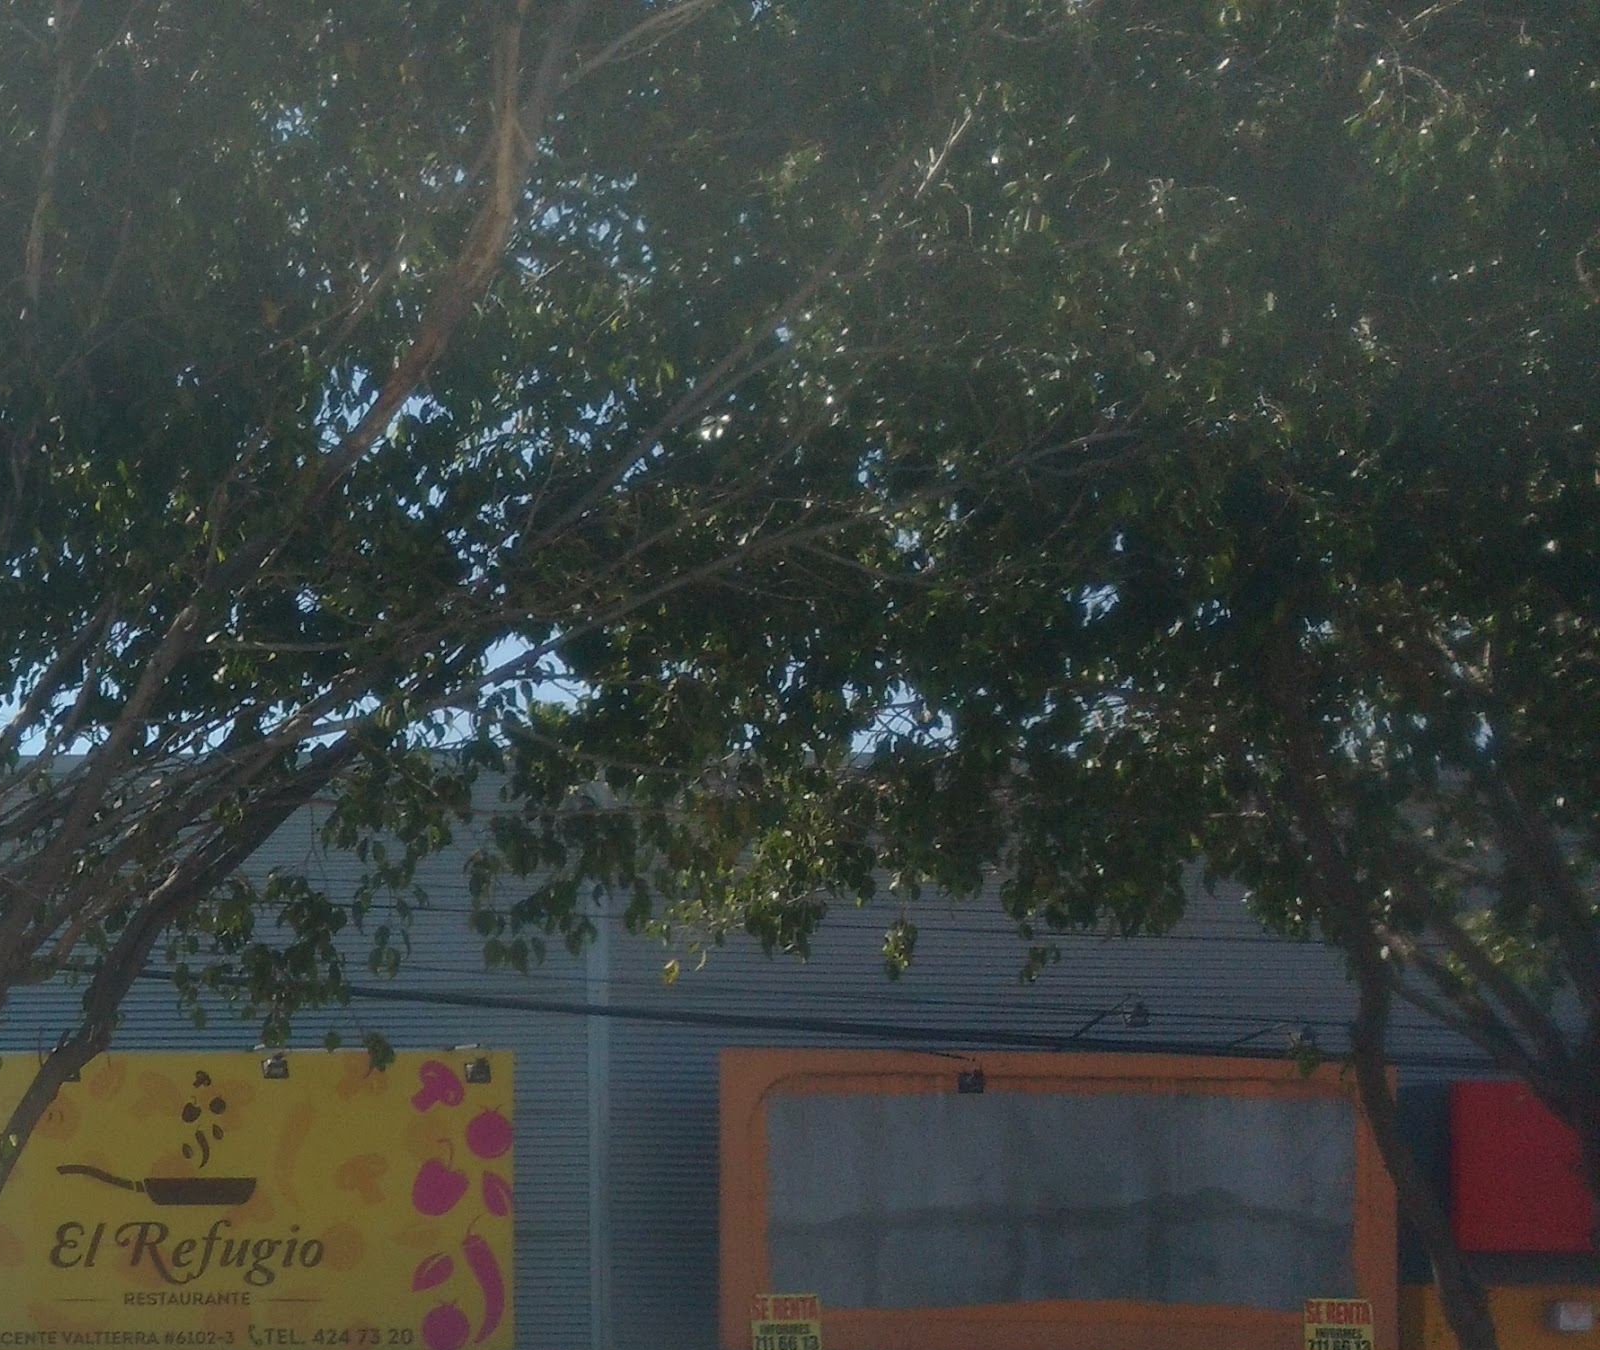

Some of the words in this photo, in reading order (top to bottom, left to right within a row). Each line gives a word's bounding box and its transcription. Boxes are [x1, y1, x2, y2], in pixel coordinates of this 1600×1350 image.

[48, 1220, 101, 1271] El
[113, 1219, 325, 1288] Refugio
[122, 1290, 252, 1306] RESTAURANTE
[751, 1297, 769, 1321] SE
[772, 1297, 819, 1321] RENTA
[1305, 1301, 1321, 1324] SE
[1326, 1301, 1371, 1325] RENTA
[62, 1330, 159, 1346] VALTIERRA
[164, 1329, 236, 1346] #6102-3
[263, 1328, 306, 1346] TEL.
[312, 1327, 351, 1346] 424
[358, 1327, 382, 1346] 73
[387, 1327, 414, 1346] 20
[759, 1323, 811, 1335] INFORMES
[1315, 1327, 1363, 1339] INFORMES
